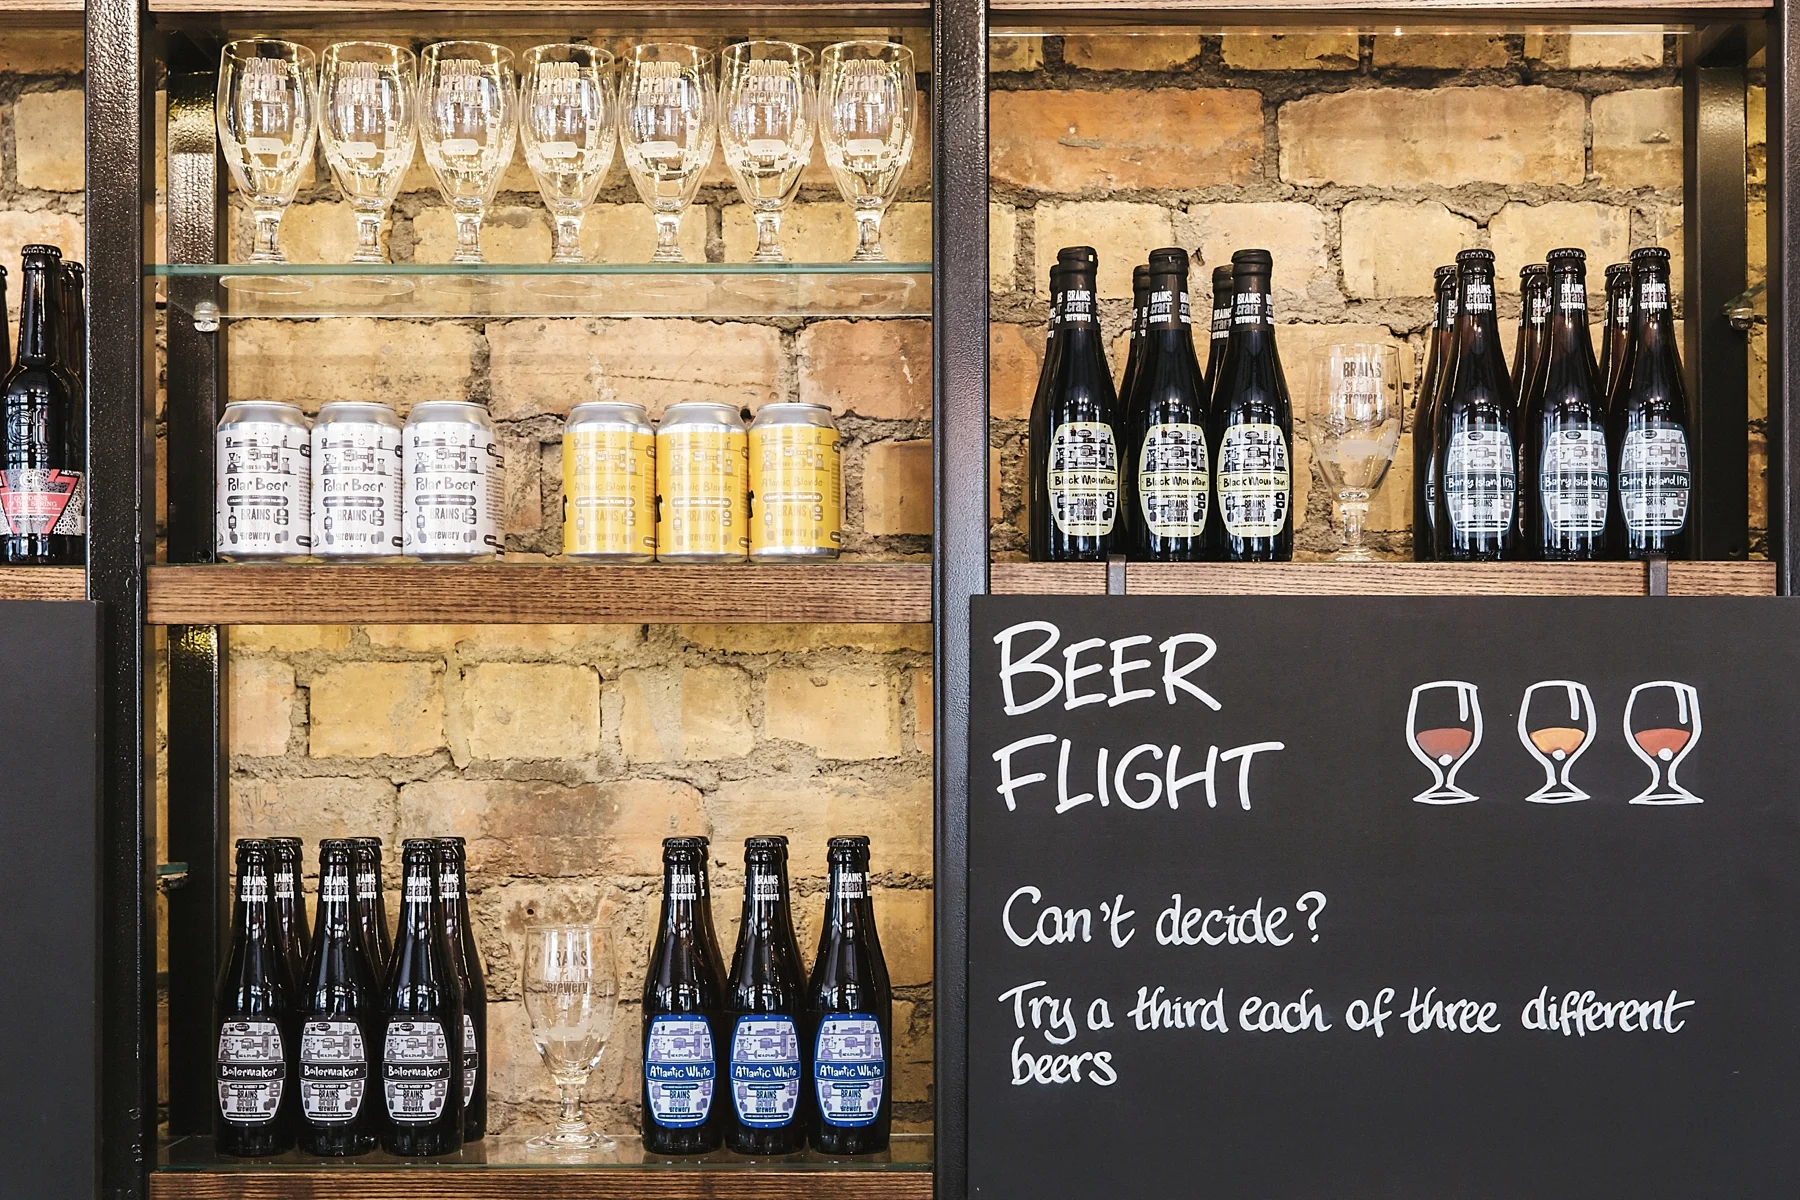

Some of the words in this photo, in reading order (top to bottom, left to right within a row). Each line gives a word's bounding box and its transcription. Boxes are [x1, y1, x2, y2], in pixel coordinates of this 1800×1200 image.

[245, 57, 288, 75] BRAINS
[338, 61, 379, 79] BRAINS
[440, 59, 481, 76] BRAINS
[539, 62, 579, 78] BRAINS
[640, 61, 681, 78] BRAINS
[749, 59, 790, 76] BRAINS
[845, 59, 886, 76] BRAINS
[1467, 284, 1491, 295] BRAINS
[1561, 283, 1584, 294] BRAINS
[1641, 283, 1666, 294] BRAINS
[1067, 290, 1091, 302] BRAINS
[1151, 291, 1172, 303] BRAINS
[1237, 292, 1260, 304] BRAINS
[1343, 361, 1382, 378] BRAINS
[228, 477, 252, 491] Polar
[256, 477, 288, 491] Beer
[324, 478, 348, 492] Polar
[352, 478, 383, 492] Beer
[416, 477, 441, 491] Polar
[445, 476, 476, 491] Beer
[1055, 474, 1079, 486] Black
[1146, 476, 1170, 487] Black
[1224, 478, 1247, 487] Black
[1448, 477, 1475, 489] Bary
[1503, 477, 1513, 489] IPA
[1677, 475, 1688, 487] IPA
[241, 508, 271, 520] BRAINS
[338, 509, 367, 521] BRAINS
[430, 508, 459, 520] BRAINS
[993, 621, 1222, 716] BEER
[992, 734, 1285, 814] FLIGHT
[242, 876, 267, 886] BRAINS
[324, 876, 349, 886] BRAINS
[407, 876, 431, 886] BRAINS
[672, 874, 696, 884] BRAINS
[755, 875, 779, 884] BRAINS
[839, 873, 862, 883] BRAINS
[1003, 886, 1135, 948] Can't
[1156, 891, 1327, 946] decide?
[998, 980, 1077, 1044] Try
[1087, 998, 1114, 1031] a
[1127, 986, 1229, 1033] third
[1239, 988, 1332, 1033] each
[1346, 987, 1395, 1037] of
[1400, 987, 1501, 1034] three
[1521, 985, 1695, 1037] different
[1012, 1036, 1117, 1086] beers
[222, 1065, 277, 1078] Boilermaker
[304, 1065, 359, 1078] Boilermaker
[388, 1065, 443, 1078] Boilermaker
[650, 1065, 684, 1078] Atlantic
[686, 1066, 711, 1078] White
[735, 1065, 771, 1078] Atlantic
[772, 1066, 797, 1079] White
[820, 1065, 856, 1077] Atlantic
[857, 1065, 881, 1077] White
[670, 1090, 690, 1099] BRAINS
[756, 1090, 776, 1099] BRAINS
[841, 1089, 862, 1098] BRAINS
